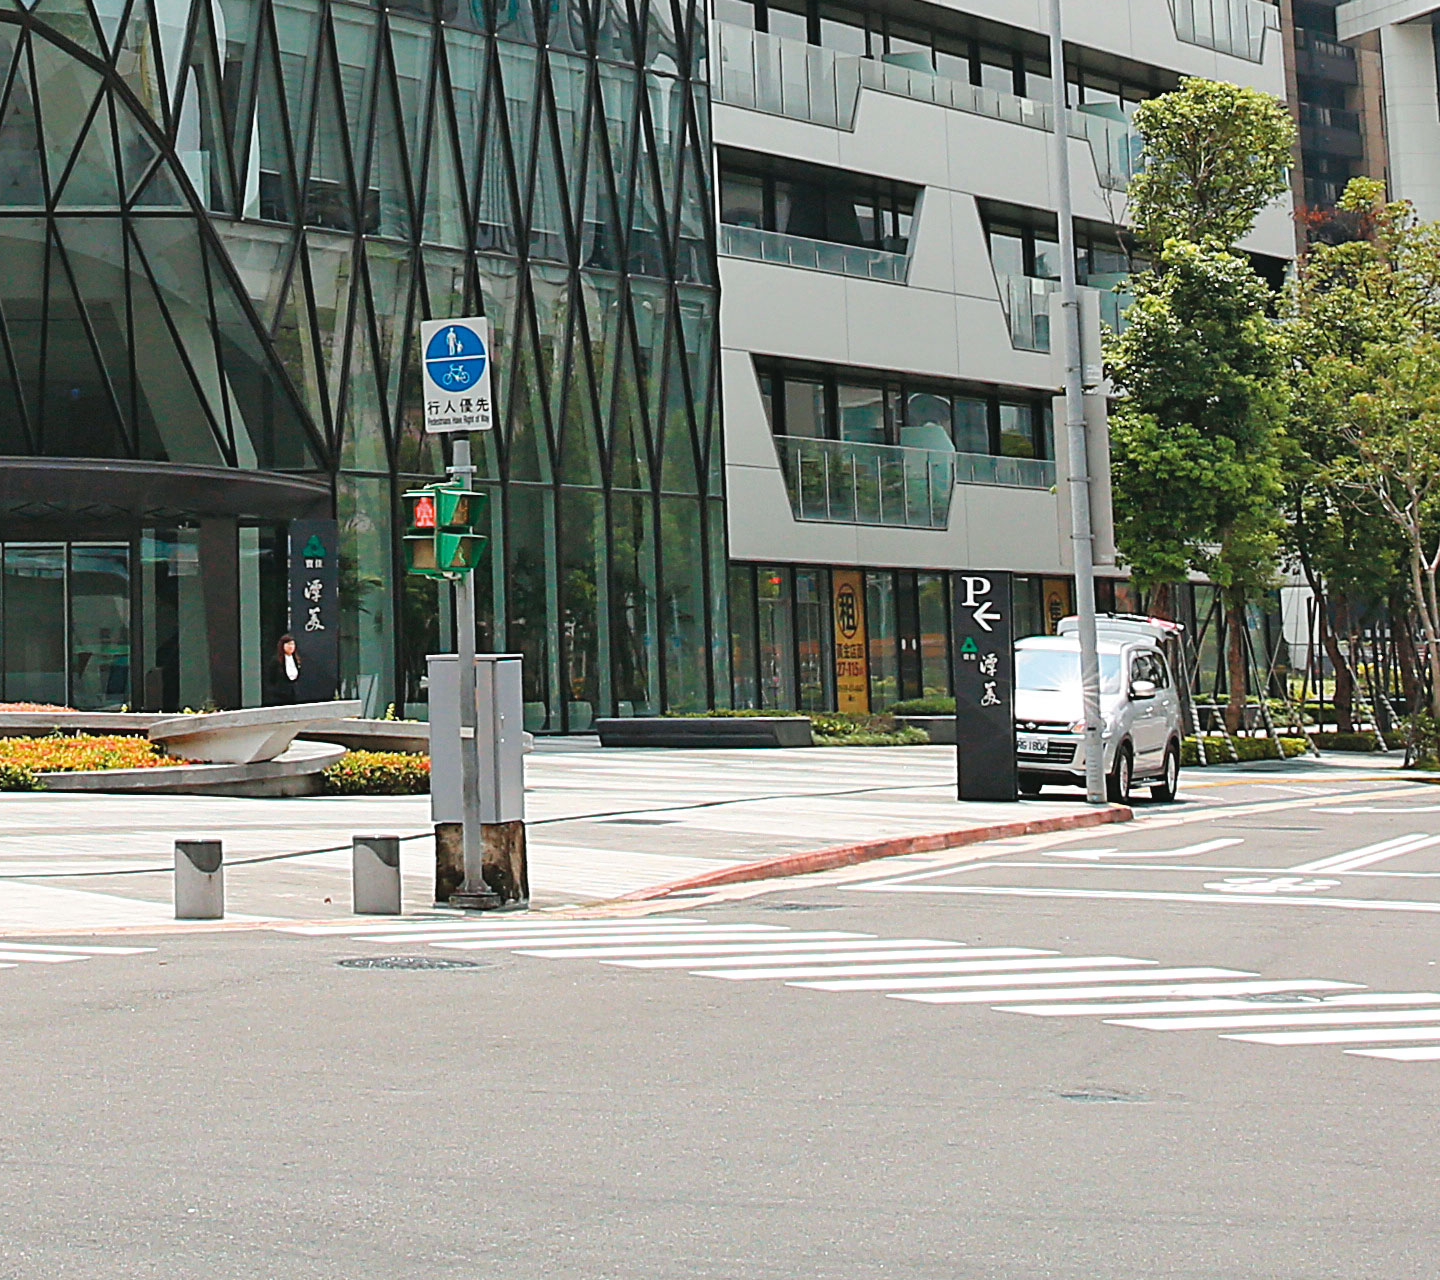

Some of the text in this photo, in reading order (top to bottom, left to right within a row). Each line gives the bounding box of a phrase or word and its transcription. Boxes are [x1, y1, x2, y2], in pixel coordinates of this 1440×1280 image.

[427, 397, 490, 416] 行人優先
[961, 576, 991, 607] P
